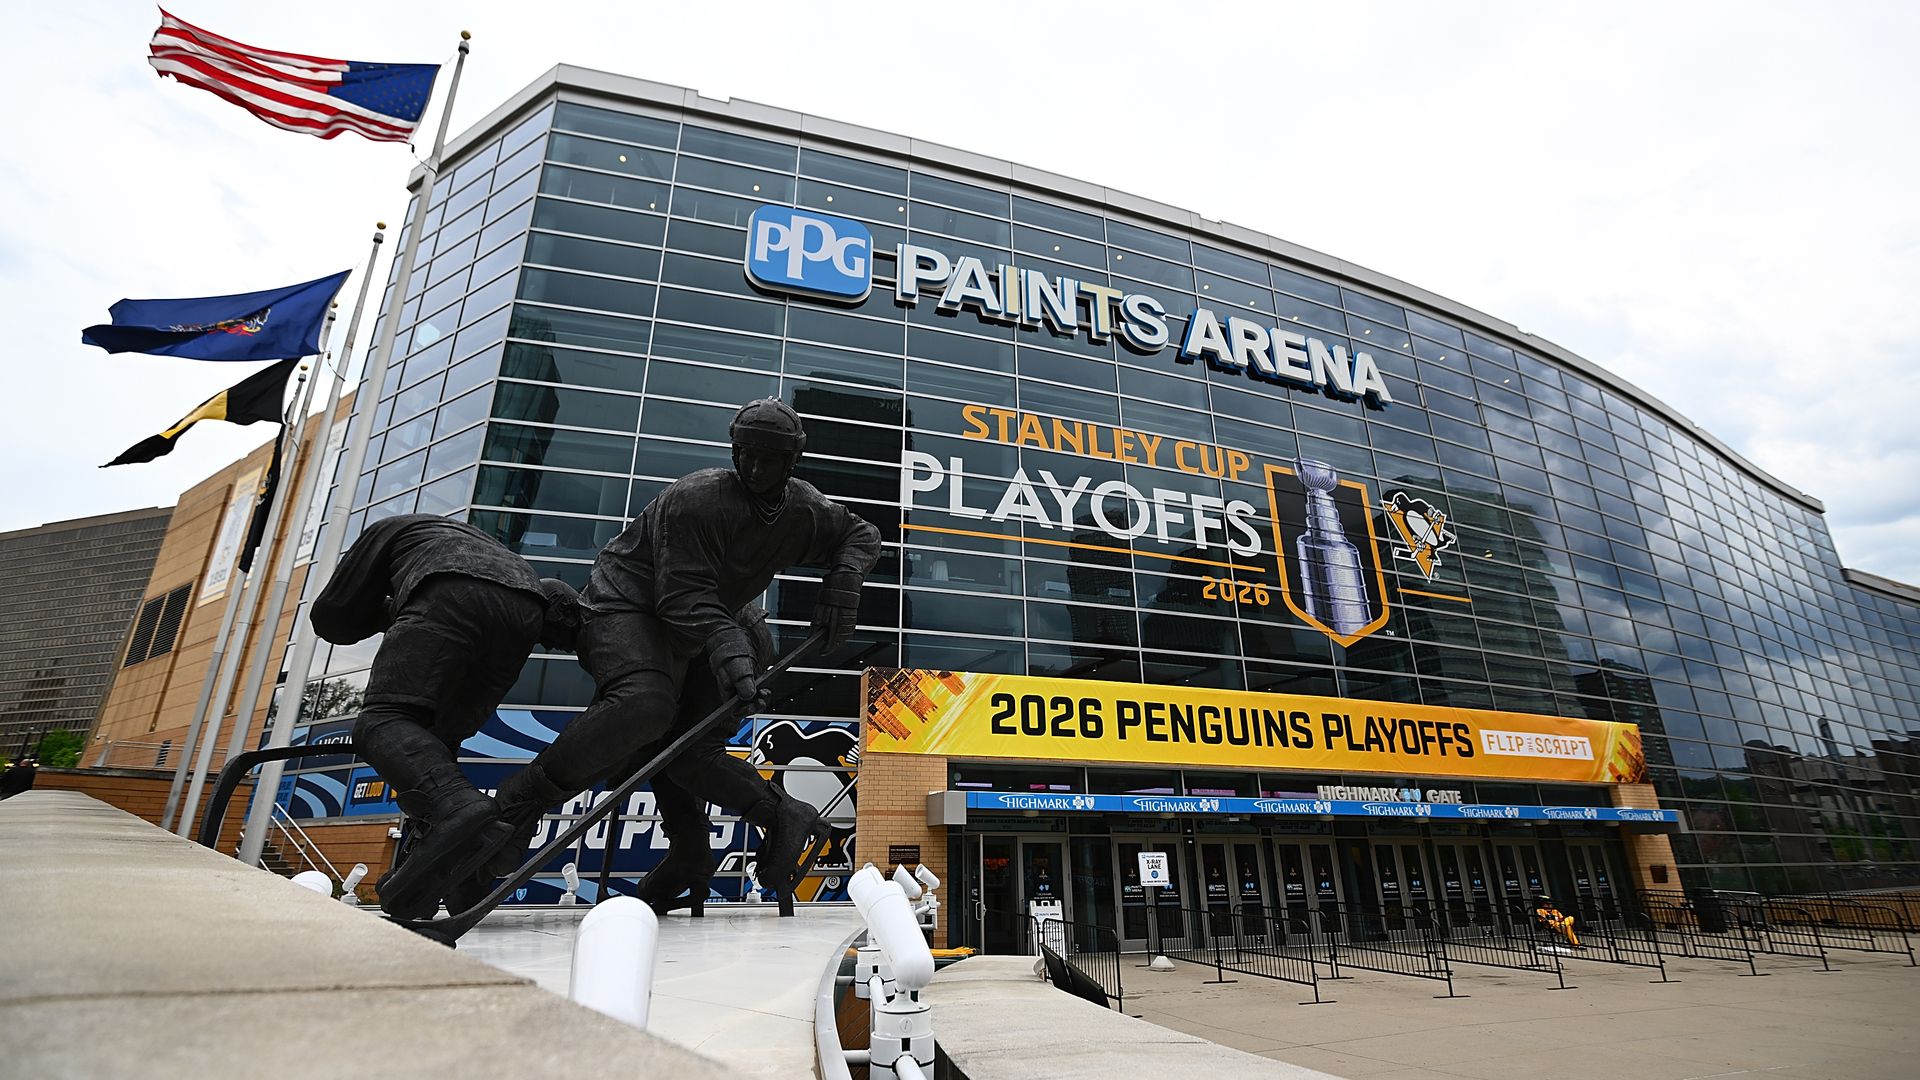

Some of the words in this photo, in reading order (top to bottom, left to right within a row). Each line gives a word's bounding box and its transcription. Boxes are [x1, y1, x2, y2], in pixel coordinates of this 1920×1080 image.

[754, 214, 866, 279] PPG
[898, 243, 1169, 351] PAINTS
[1184, 309, 1392, 404] ARENA
[961, 404, 1163, 466] STANLEY
[1174, 440, 1250, 480] CUP
[902, 450, 1262, 557] PLAYOFFS
[1202, 576, 1270, 606] 2026
[990, 693, 1103, 738] 2026
[1116, 700, 1313, 749] PENGUINS
[1322, 713, 1474, 757] PLAYOFFS
[1486, 734, 1524, 752] FLIP
[354, 783, 368, 798] GET
[365, 781, 384, 797] LOUD
[1317, 785, 1400, 802] HIGHMARK
[1426, 789, 1462, 803] GATE
[1007, 796, 1069, 809] HIGHMARK
[1141, 800, 1197, 812] HIGHMARK
[1260, 802, 1312, 813] HIGHMARK
[1368, 805, 1415, 816] HIGHMARK
[1463, 808, 1504, 818] HIGHMARK
[1547, 809, 1584, 819] HIGHMARK
